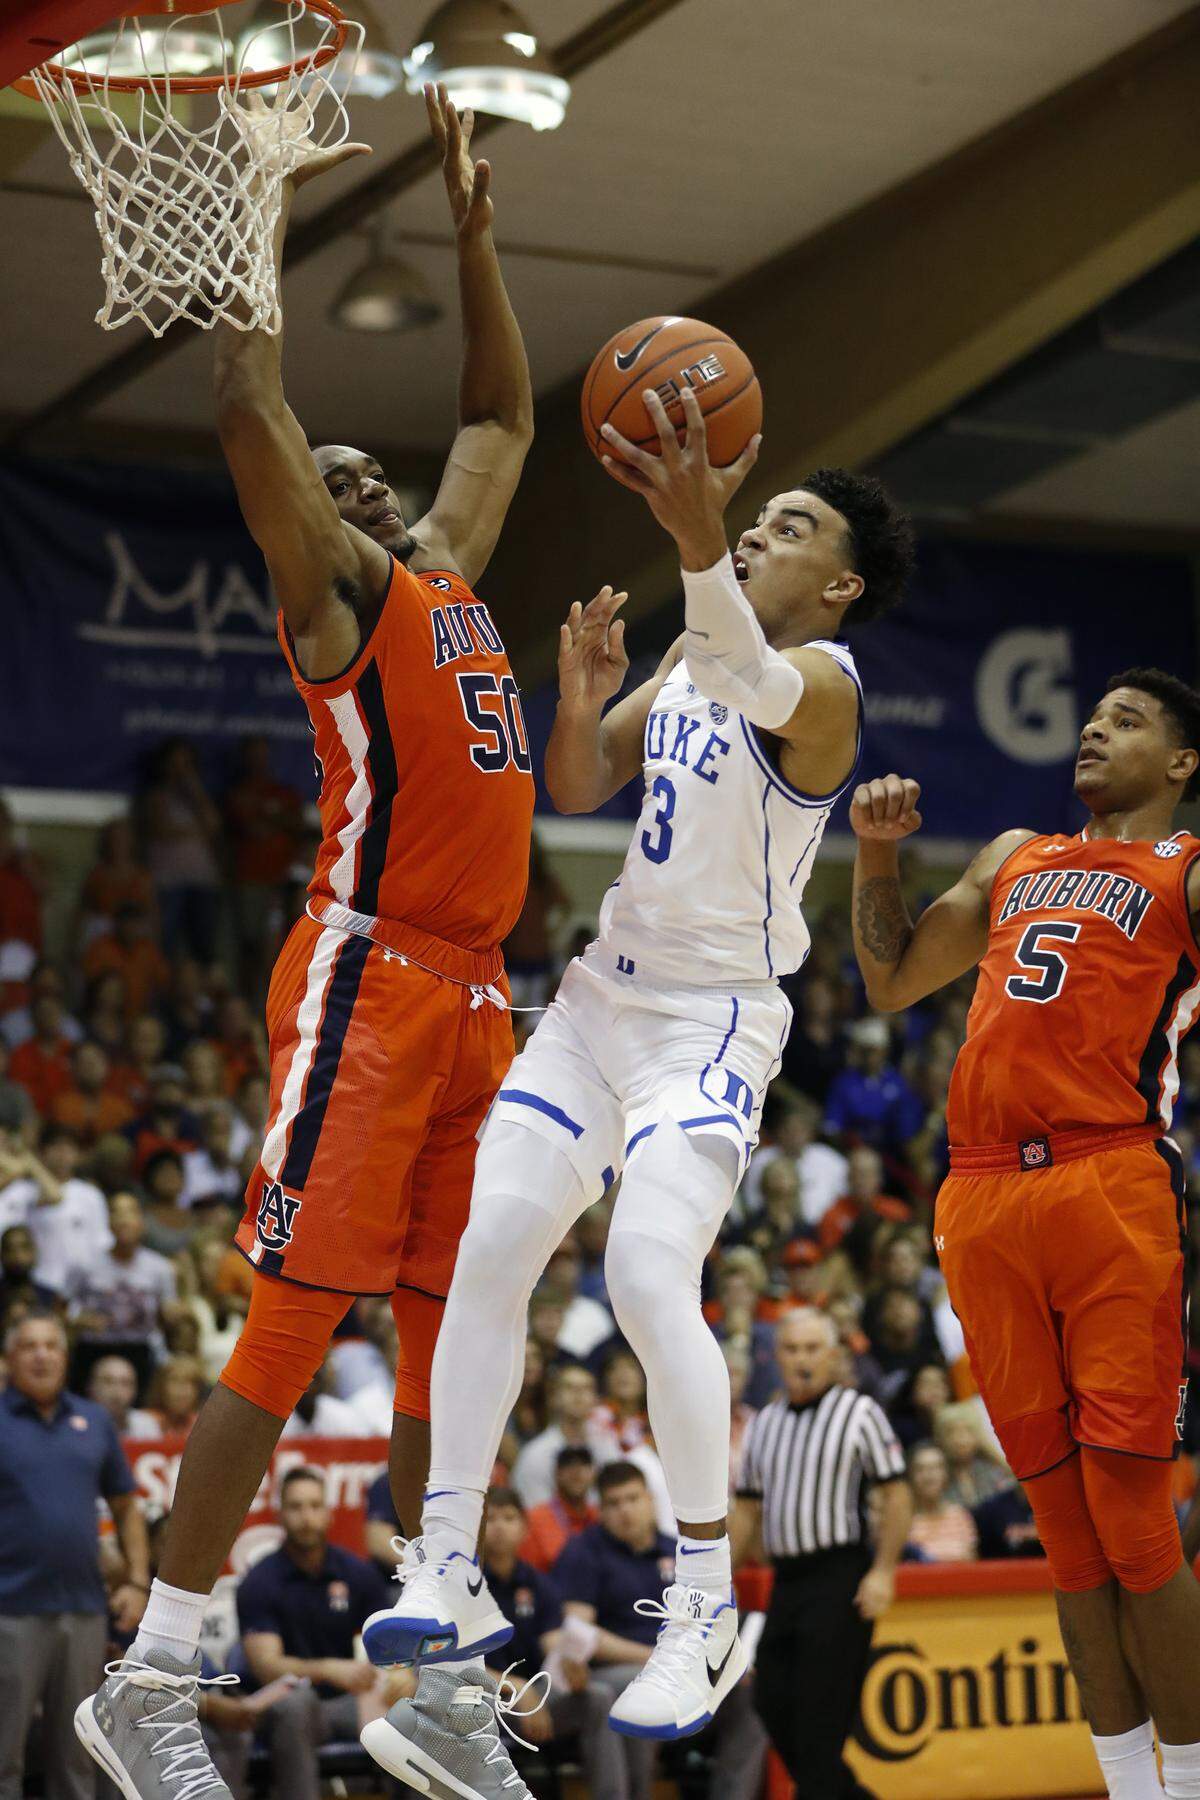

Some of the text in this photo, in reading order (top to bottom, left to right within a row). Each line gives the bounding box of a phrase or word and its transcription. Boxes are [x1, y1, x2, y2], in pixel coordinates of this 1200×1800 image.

[456, 673, 532, 774] 50
[641, 775, 677, 865] 3
[1154, 841, 1182, 858] SEC
[997, 869, 1156, 942] AUBURN
[1005, 920, 1082, 1005] 5
